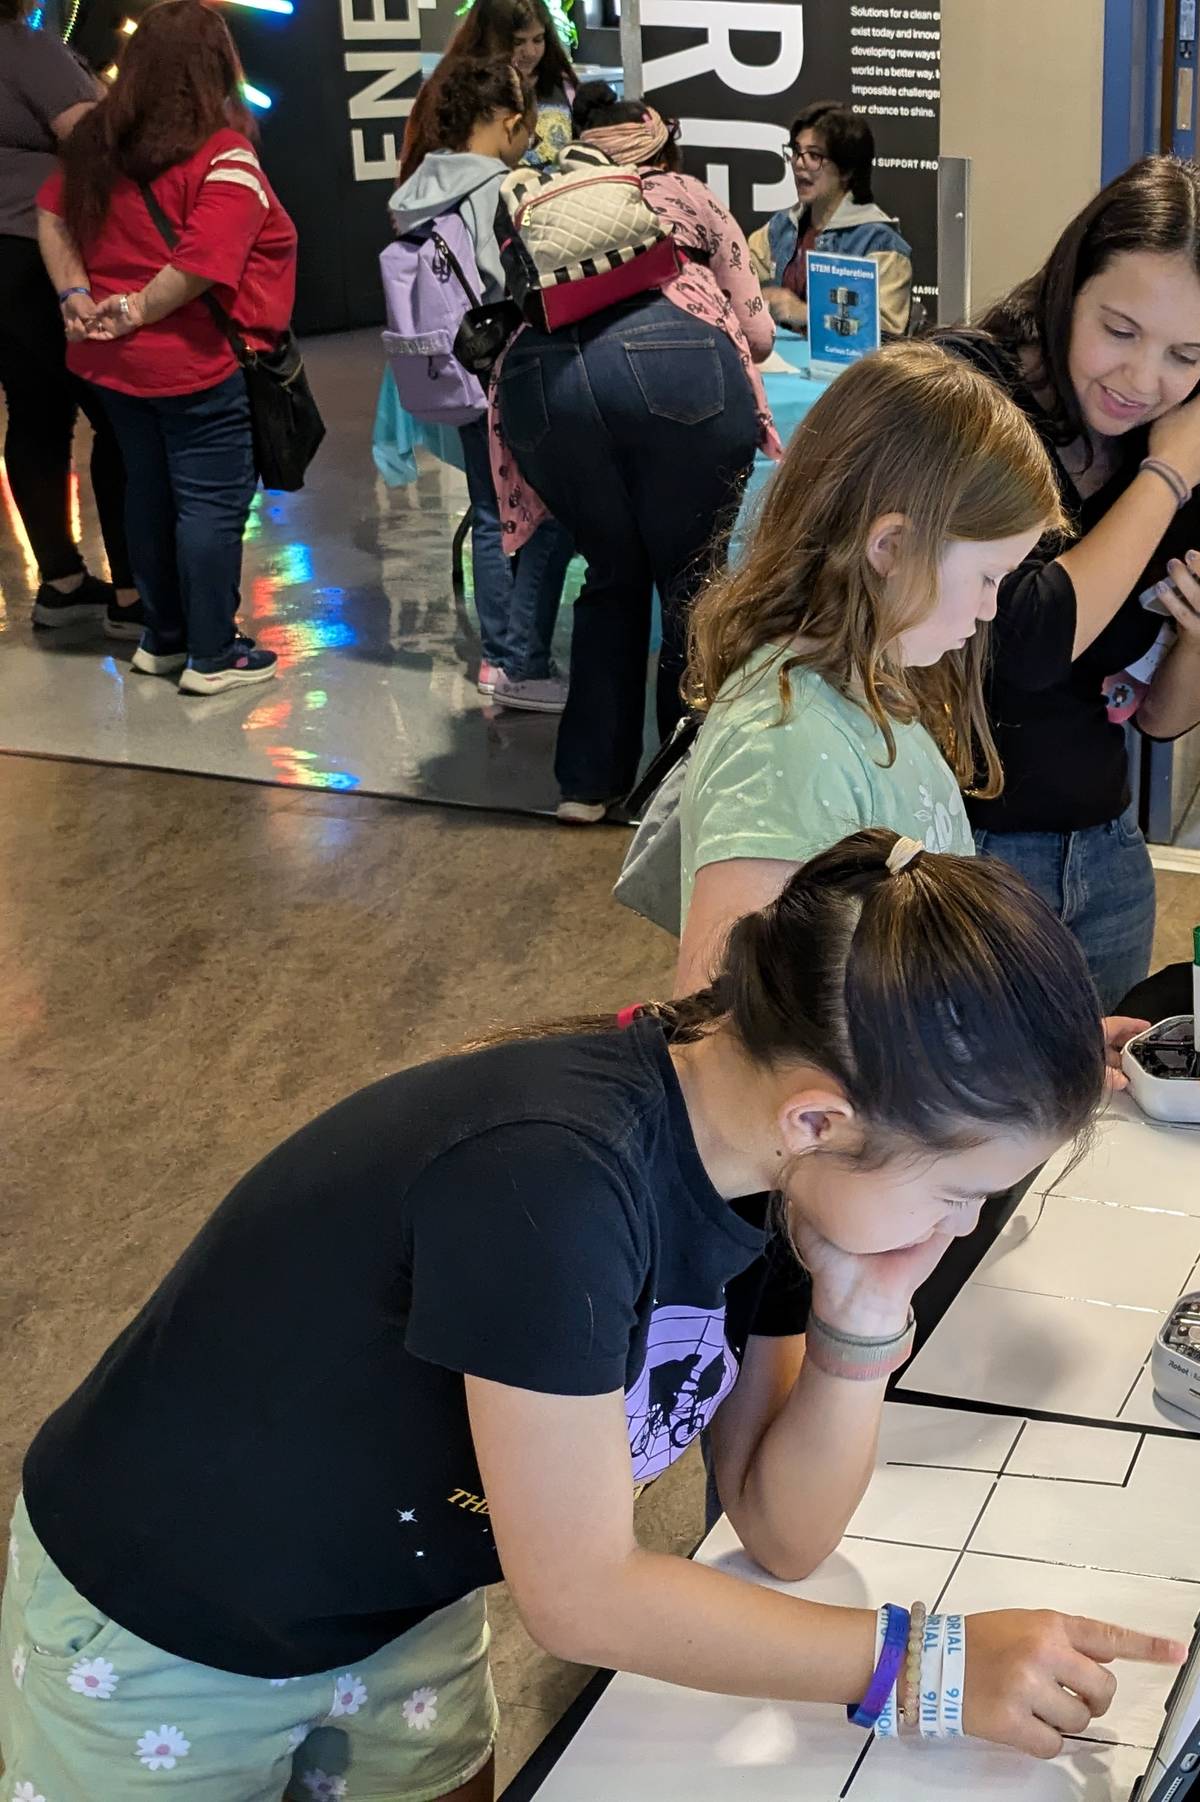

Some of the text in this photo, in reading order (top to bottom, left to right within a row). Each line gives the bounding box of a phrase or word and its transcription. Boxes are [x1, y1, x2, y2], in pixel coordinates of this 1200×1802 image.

[850, 5, 889, 18] Solutions
[890, 7, 902, 19] for
[902, 9, 909, 19] a
[909, 9, 932, 20] clean
[850, 26, 871, 37] exist
[871, 27, 895, 40] today
[895, 29, 912, 39] and
[851, 45, 896, 60] developing
[896, 48, 914, 59] new
[914, 49, 936, 62] ways
[851, 65, 875, 76] world
[875, 66, 883, 76] in
[884, 68, 890, 77] a
[890, 66, 916, 78] better
[916, 69, 935, 81] way.
[852, 104, 936, 118] our chance to shine.
[877, 157, 919, 169] SUPPORT
[810, 262, 875, 281] STEM Explorations
[922, 1691, 939, 1722] 9/11
[944, 1687, 960, 1720] 9/11
